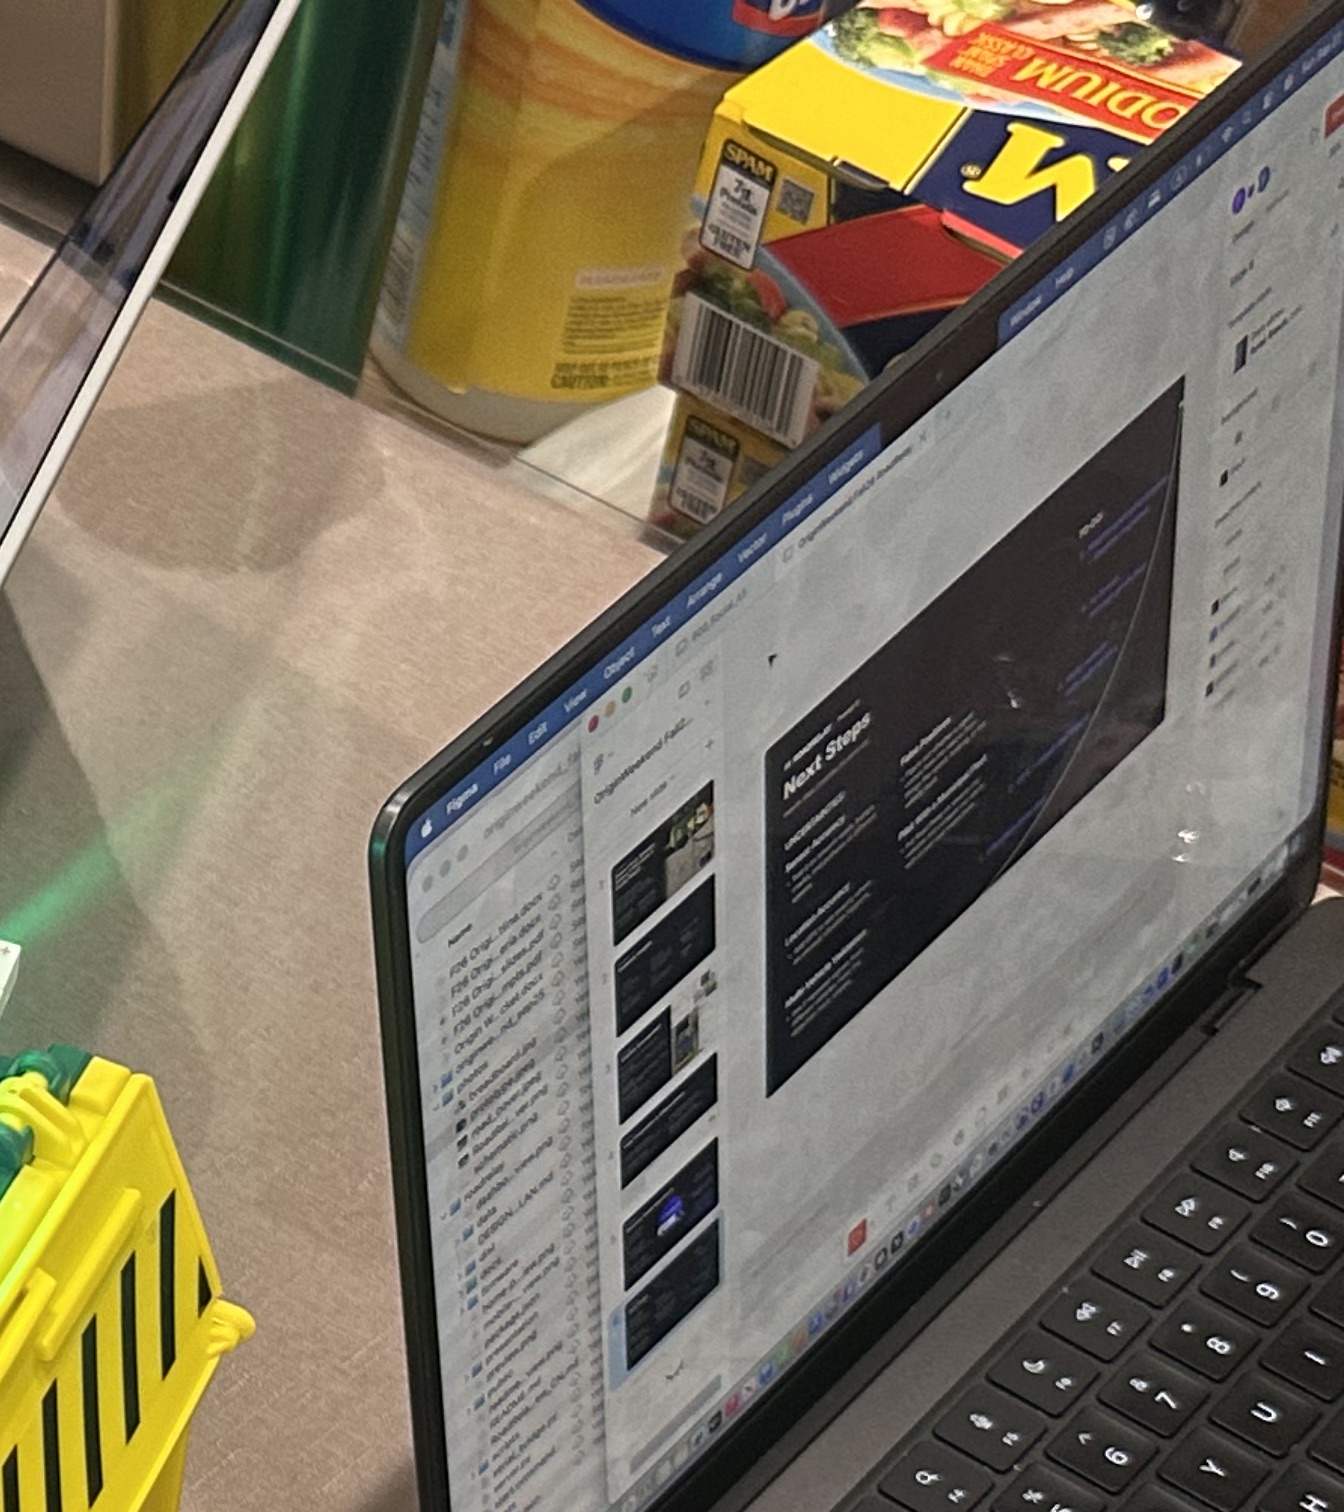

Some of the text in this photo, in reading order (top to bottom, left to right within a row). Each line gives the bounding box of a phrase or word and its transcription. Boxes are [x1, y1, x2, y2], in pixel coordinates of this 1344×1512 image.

[723, 143, 774, 182] SPAM
[736, 533, 769, 565] Vector
[685, 571, 724, 609] Arrange
[651, 614, 672, 639] Text
[603, 645, 637, 681] Object
[562, 688, 589, 714] View
[527, 720, 550, 747] Edit
[492, 753, 513, 777] File
[782, 712, 872, 800] Next Steps
[445, 782, 480, 816] Figma
